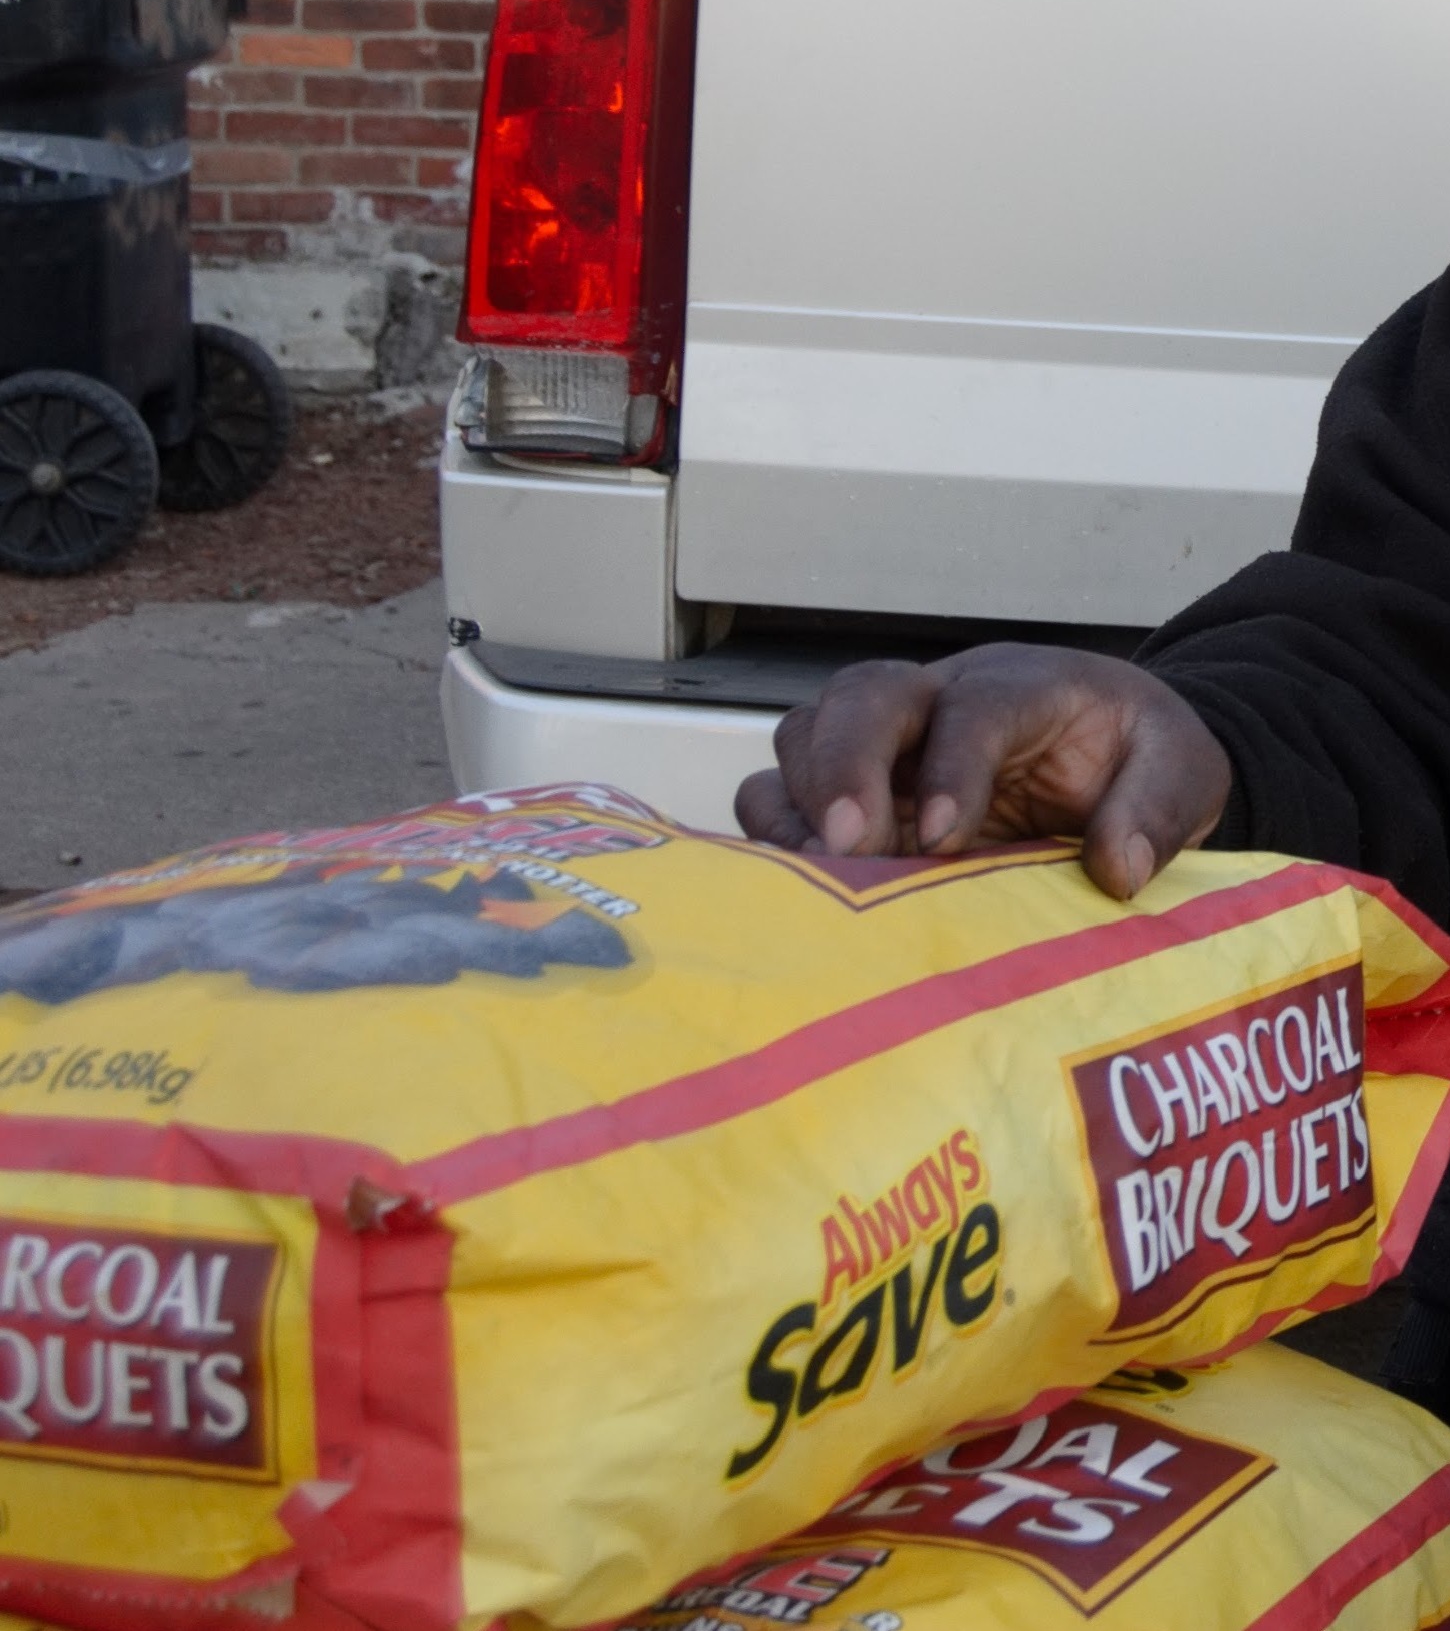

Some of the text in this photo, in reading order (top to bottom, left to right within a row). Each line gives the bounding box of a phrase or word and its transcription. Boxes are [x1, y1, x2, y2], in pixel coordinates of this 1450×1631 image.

[1108, 986, 1362, 1158] CHARCOAL
[820, 1129, 982, 1307] Always
[1115, 1085, 1369, 1292] BRIQUETS
[0, 1233, 235, 1335] RCOAL
[724, 1202, 1001, 1481] Save
